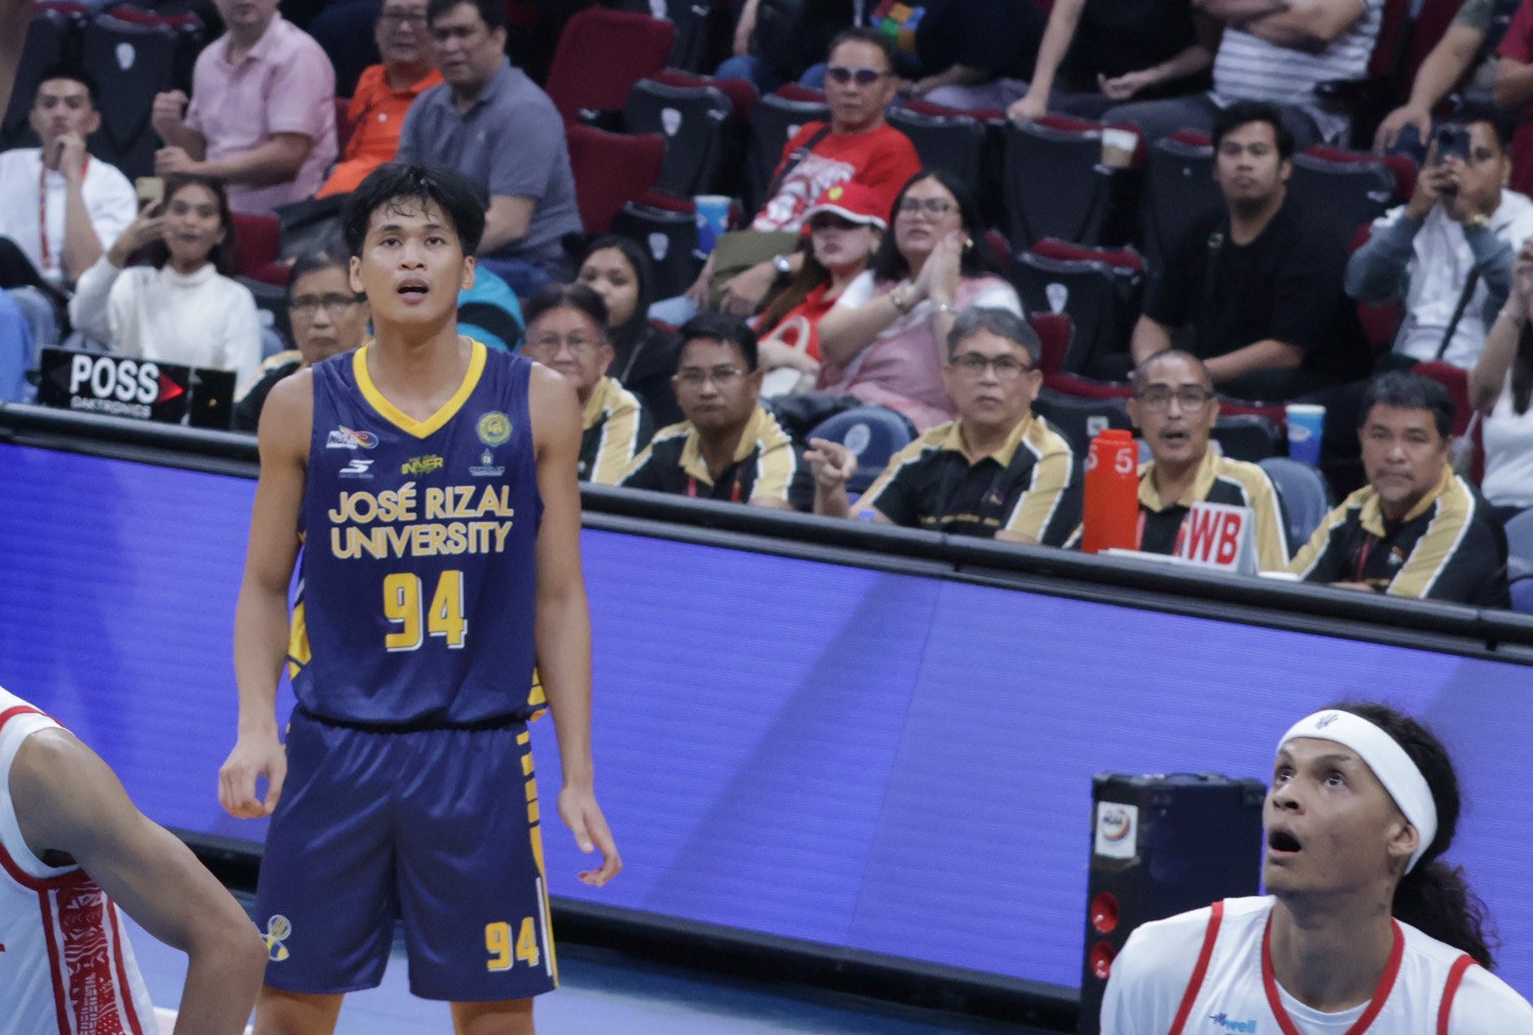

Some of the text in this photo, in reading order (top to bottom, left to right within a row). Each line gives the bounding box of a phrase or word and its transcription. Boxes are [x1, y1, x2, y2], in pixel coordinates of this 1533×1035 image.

[69, 354, 159, 404] POSS
[1114, 448, 1133, 474] 5
[328, 482, 514, 524] JOSÉ RIZAL
[331, 521, 513, 559] UNIVERSITY
[1188, 507, 1242, 565] WB
[383, 569, 469, 652] 94
[485, 916, 540, 972] 94
